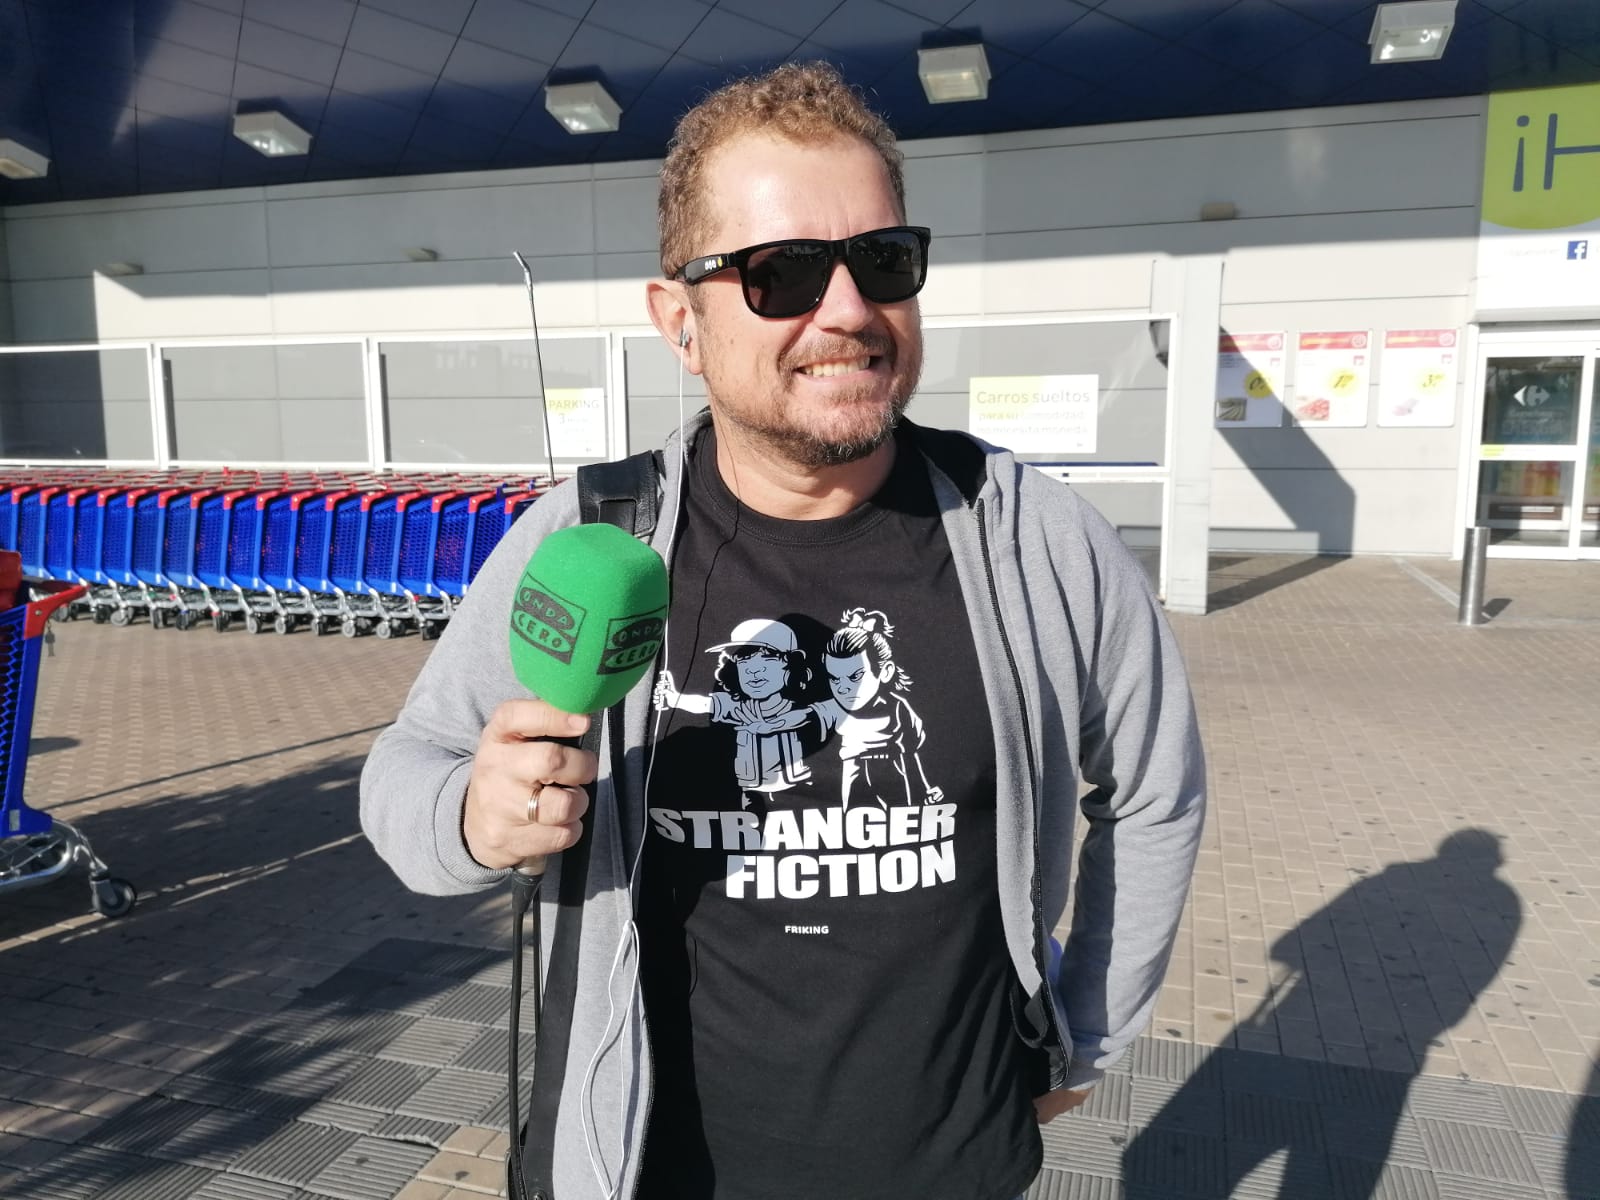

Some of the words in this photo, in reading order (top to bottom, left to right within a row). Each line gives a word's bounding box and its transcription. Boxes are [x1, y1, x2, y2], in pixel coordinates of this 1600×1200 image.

[548, 399, 601, 409] PARKING
[976, 390, 1029, 404] Carros
[1031, 389, 1091, 404] sueltos
[522, 590, 569, 626] ONDA
[517, 612, 563, 649] CERO
[649, 802, 958, 851] STRANGER
[726, 839, 956, 900] FICTION
[784, 925, 830, 935] FRIKING
